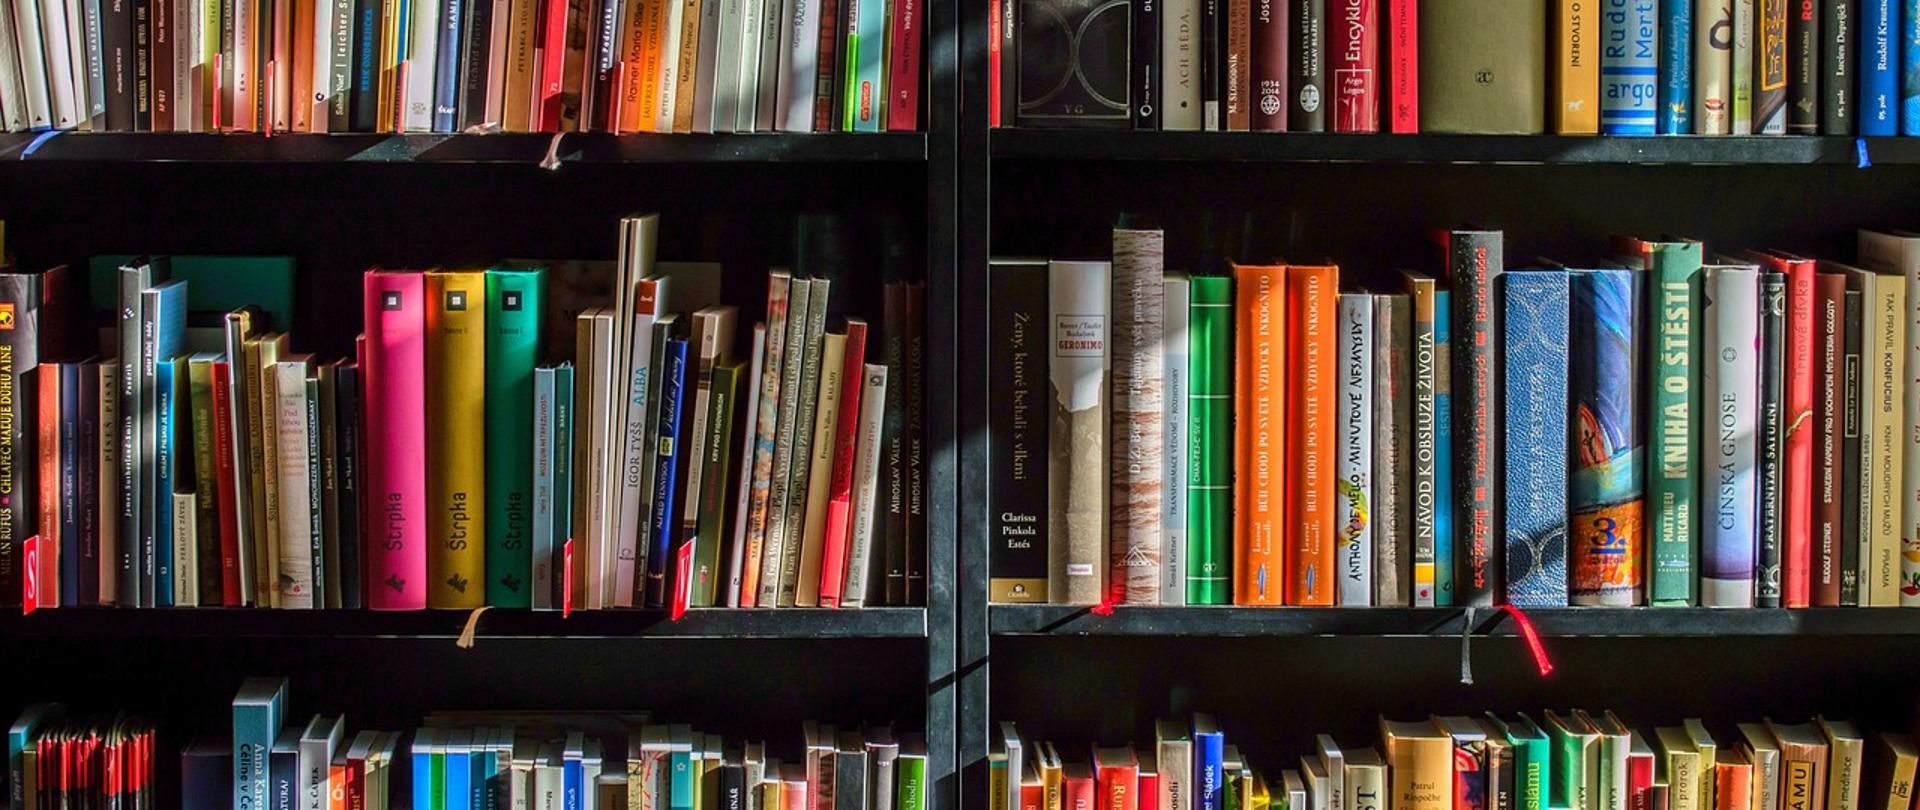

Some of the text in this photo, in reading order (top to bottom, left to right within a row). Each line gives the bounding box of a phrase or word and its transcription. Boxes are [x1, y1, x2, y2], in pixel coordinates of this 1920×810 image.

[631, 30, 642, 63] Maria
[1836, 45, 1845, 76] Lucien
[1878, 37, 1887, 71] Rudolf
[627, 66, 638, 103] Rainer
[1180, 59, 1189, 88] ACH
[1607, 83, 1655, 107] argo
[1259, 275, 1271, 336] INKOGNITO
[1308, 275, 1320, 336] INKOGNITO
[1473, 286, 1488, 322] Bardo
[1825, 299, 1836, 334] GOLGOTY
[1884, 292, 1895, 313] TAK
[1059, 340, 1103, 350] GERONIMO
[1793, 279, 1809, 380] Trnová dívka
[1884, 314, 1895, 350] PRAVIL
[0, 365, 11, 373] A
[1013, 351, 1029, 387] ktoré
[1257, 340, 1271, 392] VŽDYCKY
[1306, 340, 1320, 392] VŽDYCKY
[1660, 282, 1689, 479] KNIHA O ŠTĚSTÍ
[1883, 353, 1893, 413] KONFUCIUS
[627, 366, 647, 489] IGOR TYŠŠ ALBA
[1013, 391, 1029, 430] behali
[1257, 396, 1270, 428] SVĚTĚ
[1305, 396, 1319, 428] SVĚTĚ
[1440, 394, 1452, 437] SESTUP
[1824, 417, 1834, 433] PRO
[1258, 431, 1269, 447] PO
[1307, 431, 1319, 447] PO
[1348, 392, 1363, 466] MINUTOVÉ
[1415, 331, 1432, 538] NÁVOD K OBSLUZE ŽIVOTA
[1883, 425, 1892, 454] KNIHY
[889, 437, 901, 466] VÁLEK
[909, 438, 922, 467] VÁLEK
[1013, 442, 1029, 481] vlkmi
[1717, 392, 1738, 531] ČÍNSKÁ GNOSE
[1824, 434, 1834, 466] KAMENY
[1167, 367, 1180, 589] Tomáš TRANSFORMACE VĚDOMÍ ROZHOVORY
[1257, 451, 1270, 486] CHODÍ
[1305, 451, 1319, 486] CHODÍ
[1763, 402, 1777, 550] FRATERNITAS SATURNI
[890, 468, 901, 514] MIROSLAV
[910, 468, 922, 515] MIROSLAV
[1388, 435, 1400, 567] ANTHONY DE MELLO
[383, 492, 406, 551] Štrpka
[445, 492, 471, 551] Štrpka
[501, 492, 525, 551] Štrpka
[655, 500, 665, 530] ALFRED
[1001, 511, 1036, 522] Clarissa
[1001, 525, 1037, 536] Pinkola
[1662, 492, 1675, 543] MATTHIEU
[1676, 504, 1688, 543] RICARD
[1860, 500, 1870, 543] MOUDROST
[1008, 538, 1031, 549] Estés
[1348, 525, 1362, 582] ANTHONY
[1822, 522, 1832, 553] STEINER
[766, 559, 777, 577] Ivan
[785, 558, 796, 576] Ivan
[1822, 554, 1832, 585] RUDOLF
[1882, 548, 1890, 588] PRAGMA
[240, 743, 251, 792] Céline v
[254, 743, 265, 776] Anna
[310, 767, 319, 798] ČAPEK
[1203, 764, 1214, 799] Sládek
[1678, 762, 1688, 801] prorok
[1840, 756, 1852, 802] meditace
